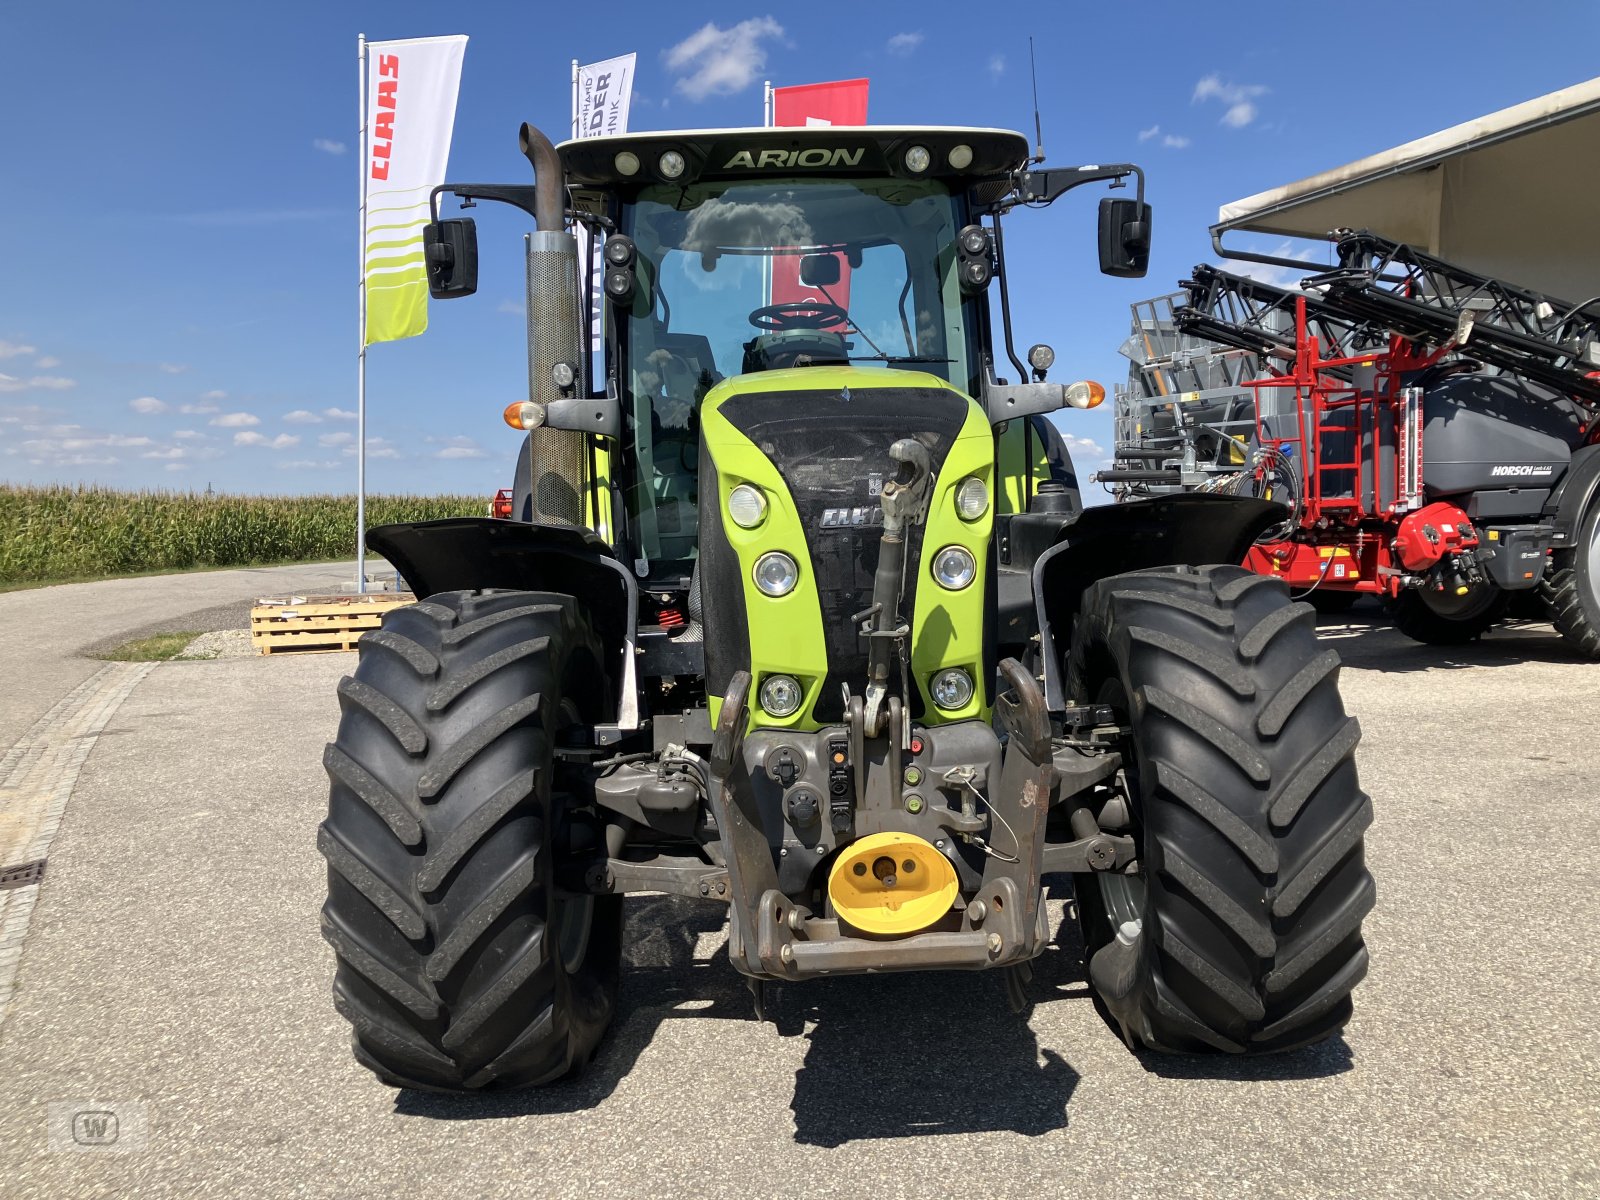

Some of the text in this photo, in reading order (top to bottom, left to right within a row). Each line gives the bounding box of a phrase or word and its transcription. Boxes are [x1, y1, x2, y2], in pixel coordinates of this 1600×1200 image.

[371, 54, 399, 181] CLAAS
[723, 148, 865, 168] ARION
[1491, 465, 1533, 476] HORSCH
